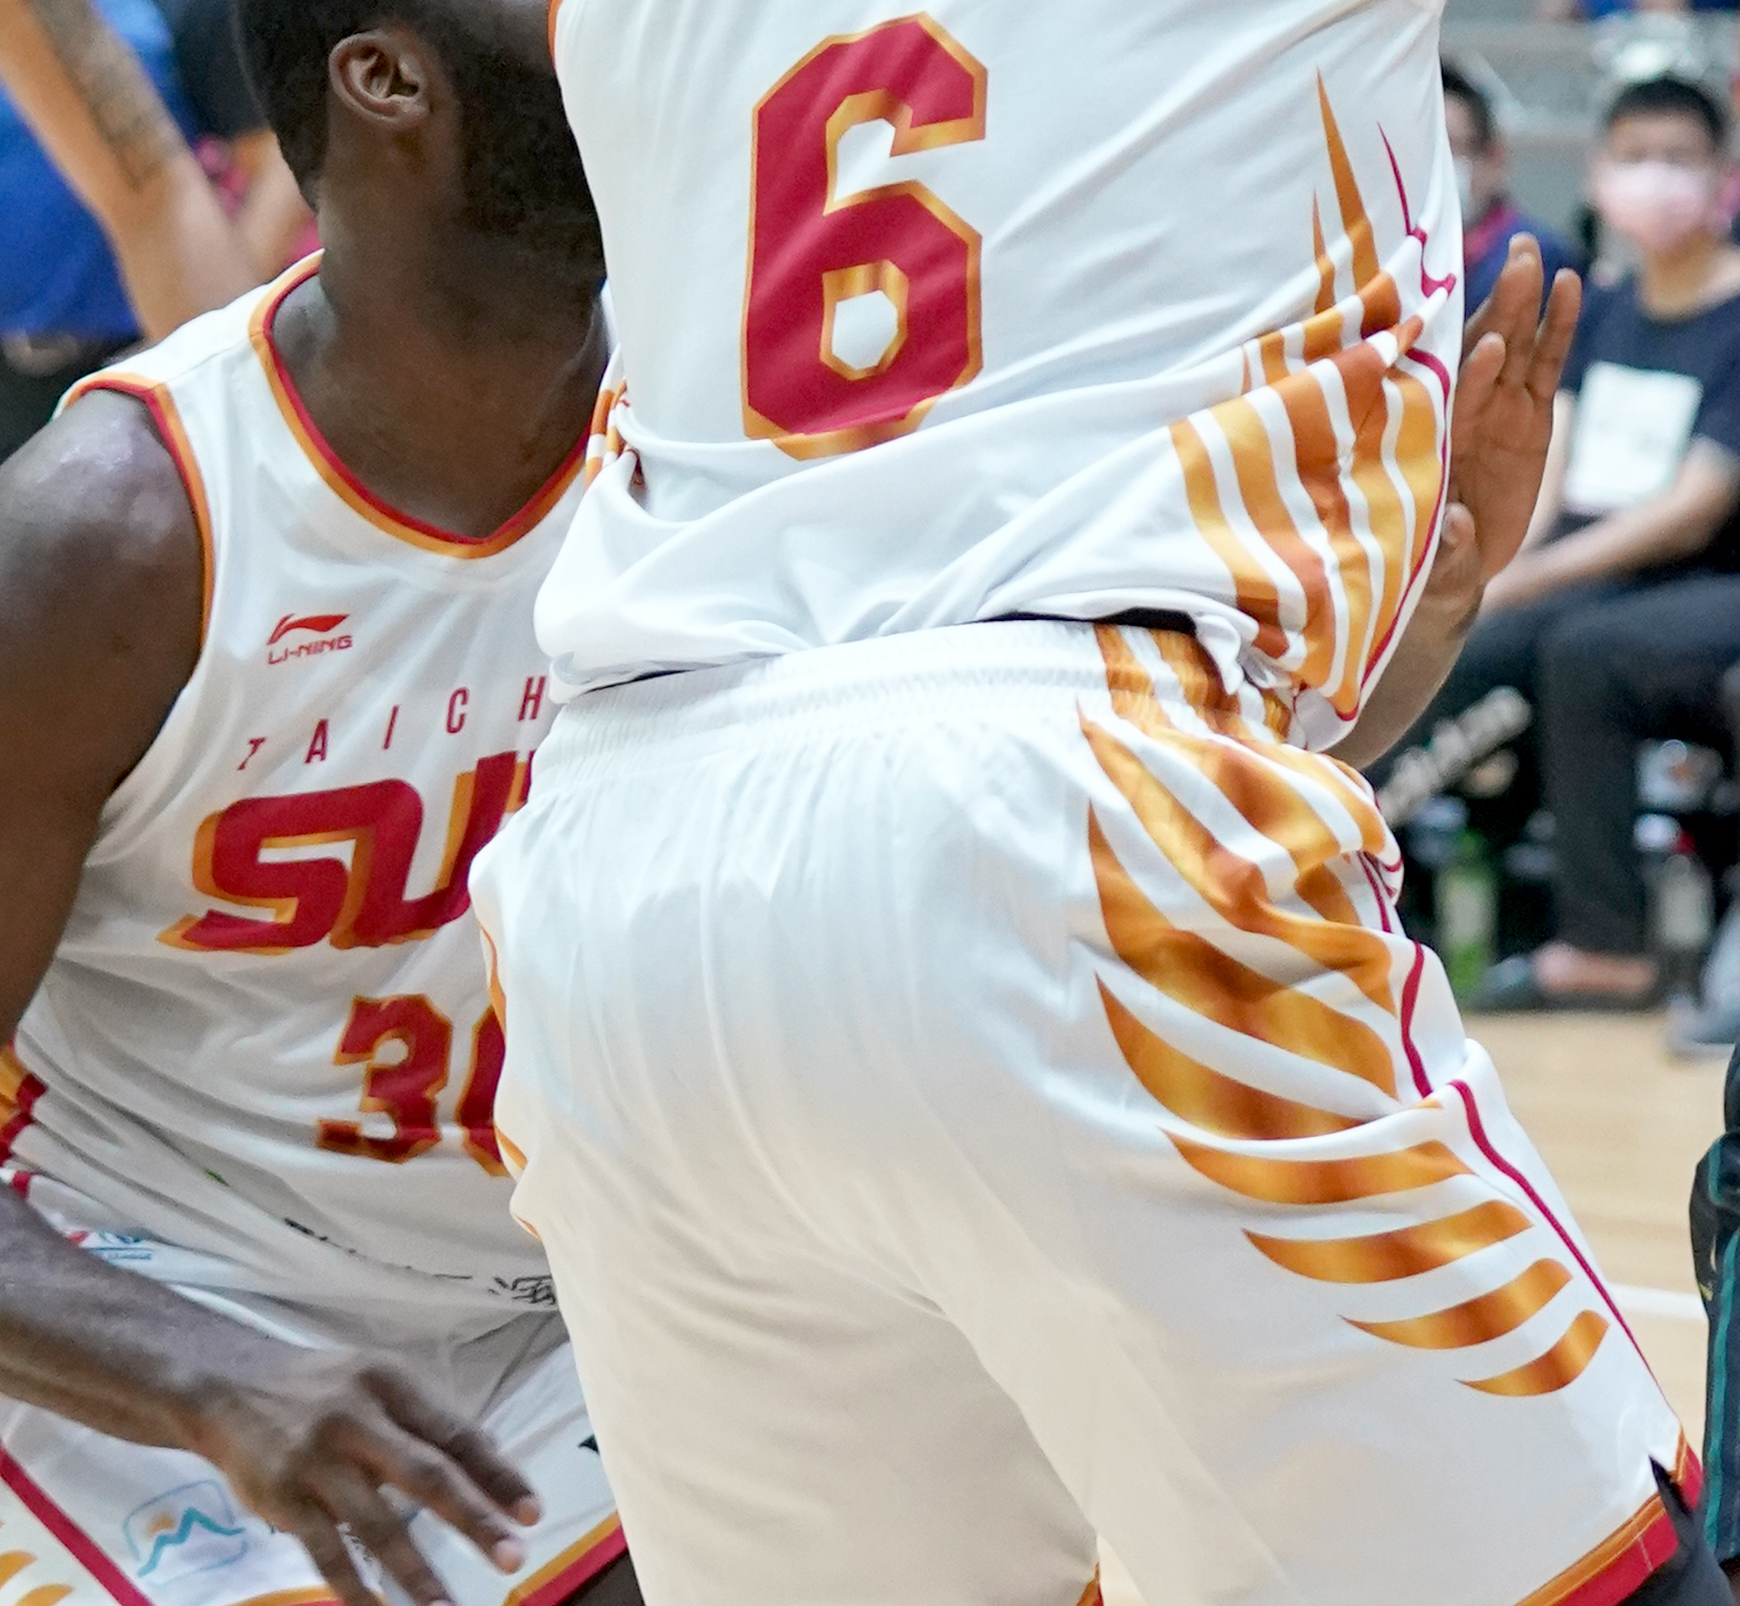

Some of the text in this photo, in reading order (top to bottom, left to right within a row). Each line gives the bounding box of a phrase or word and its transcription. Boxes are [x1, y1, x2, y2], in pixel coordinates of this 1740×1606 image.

[741, 10, 989, 462] 6
[267, 634, 354, 665] LI-NING
[156, 749, 537, 957] SU
